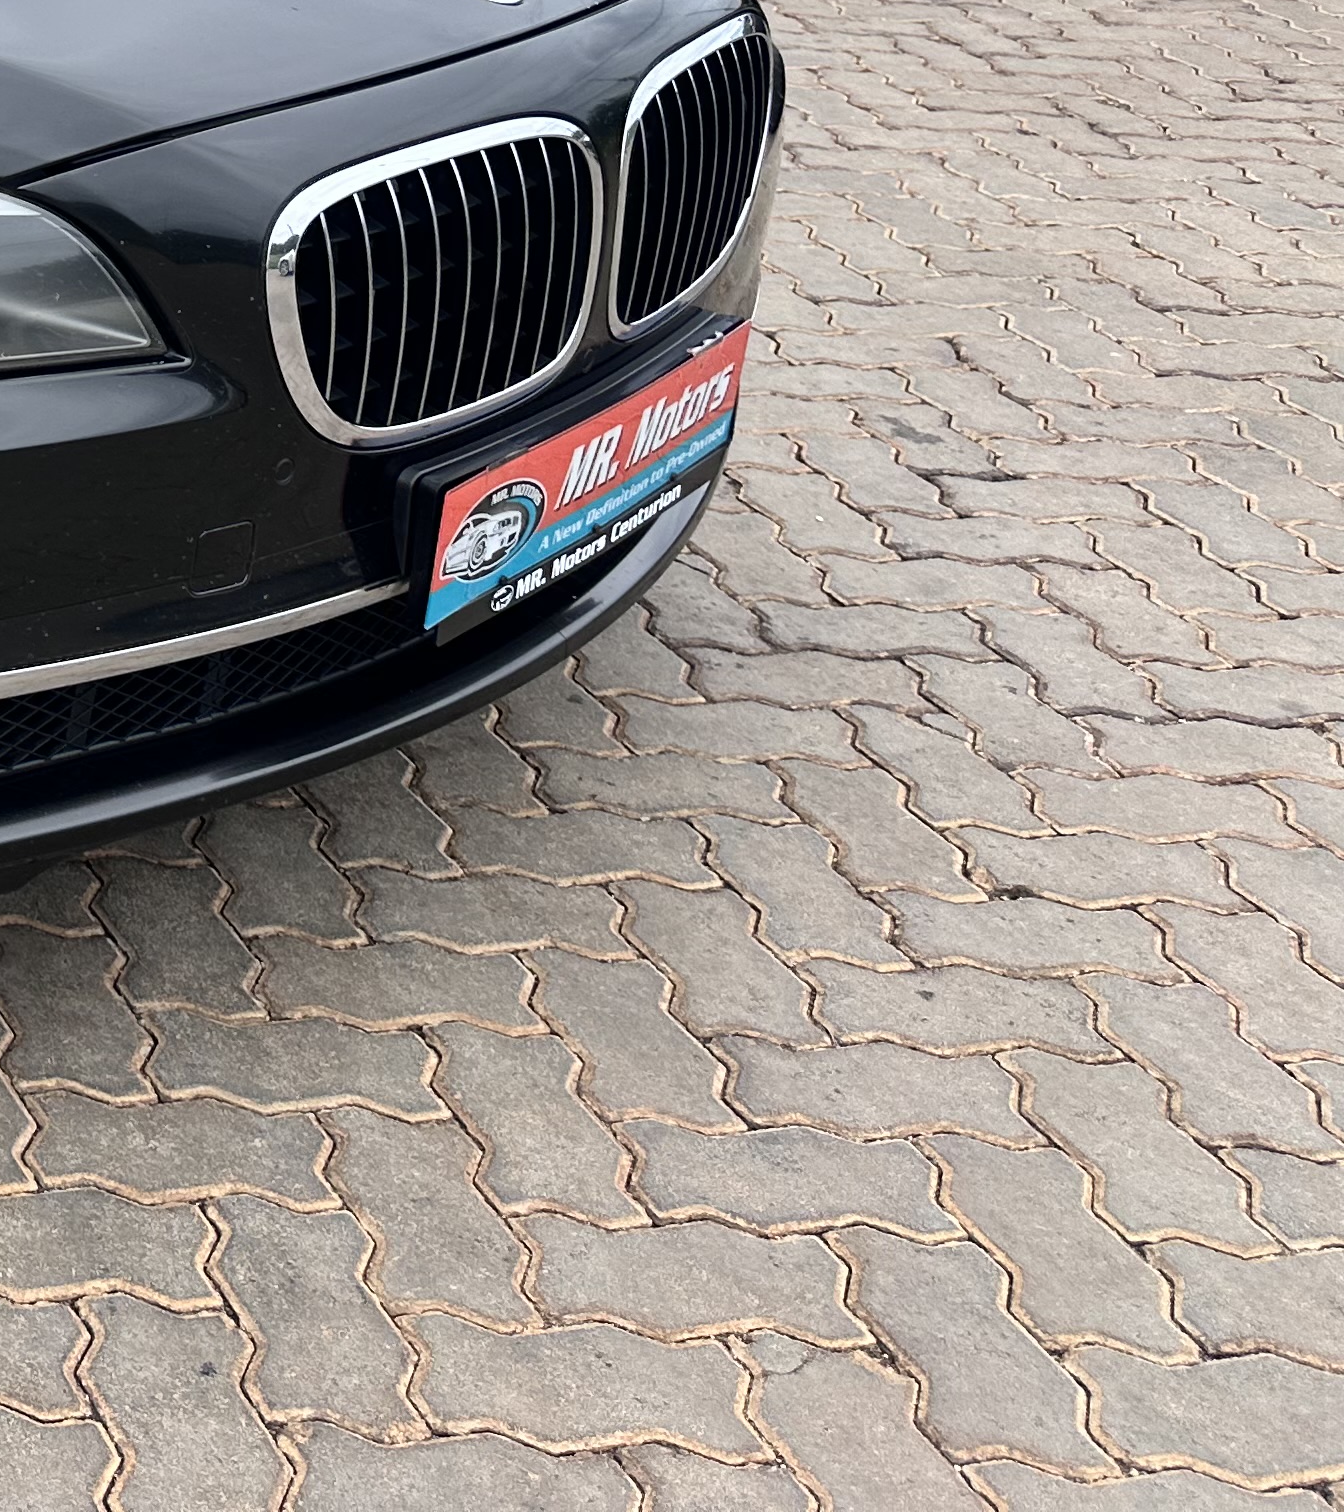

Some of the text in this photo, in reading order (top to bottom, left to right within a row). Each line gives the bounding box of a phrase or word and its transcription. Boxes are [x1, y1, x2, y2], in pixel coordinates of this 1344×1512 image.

[491, 483, 543, 507] MR. MOTORS
[538, 420, 727, 553] A New Definition to Pre-Owned
[554, 362, 736, 511] MR. Motors
[515, 484, 682, 600] MR. Motors Centurion
